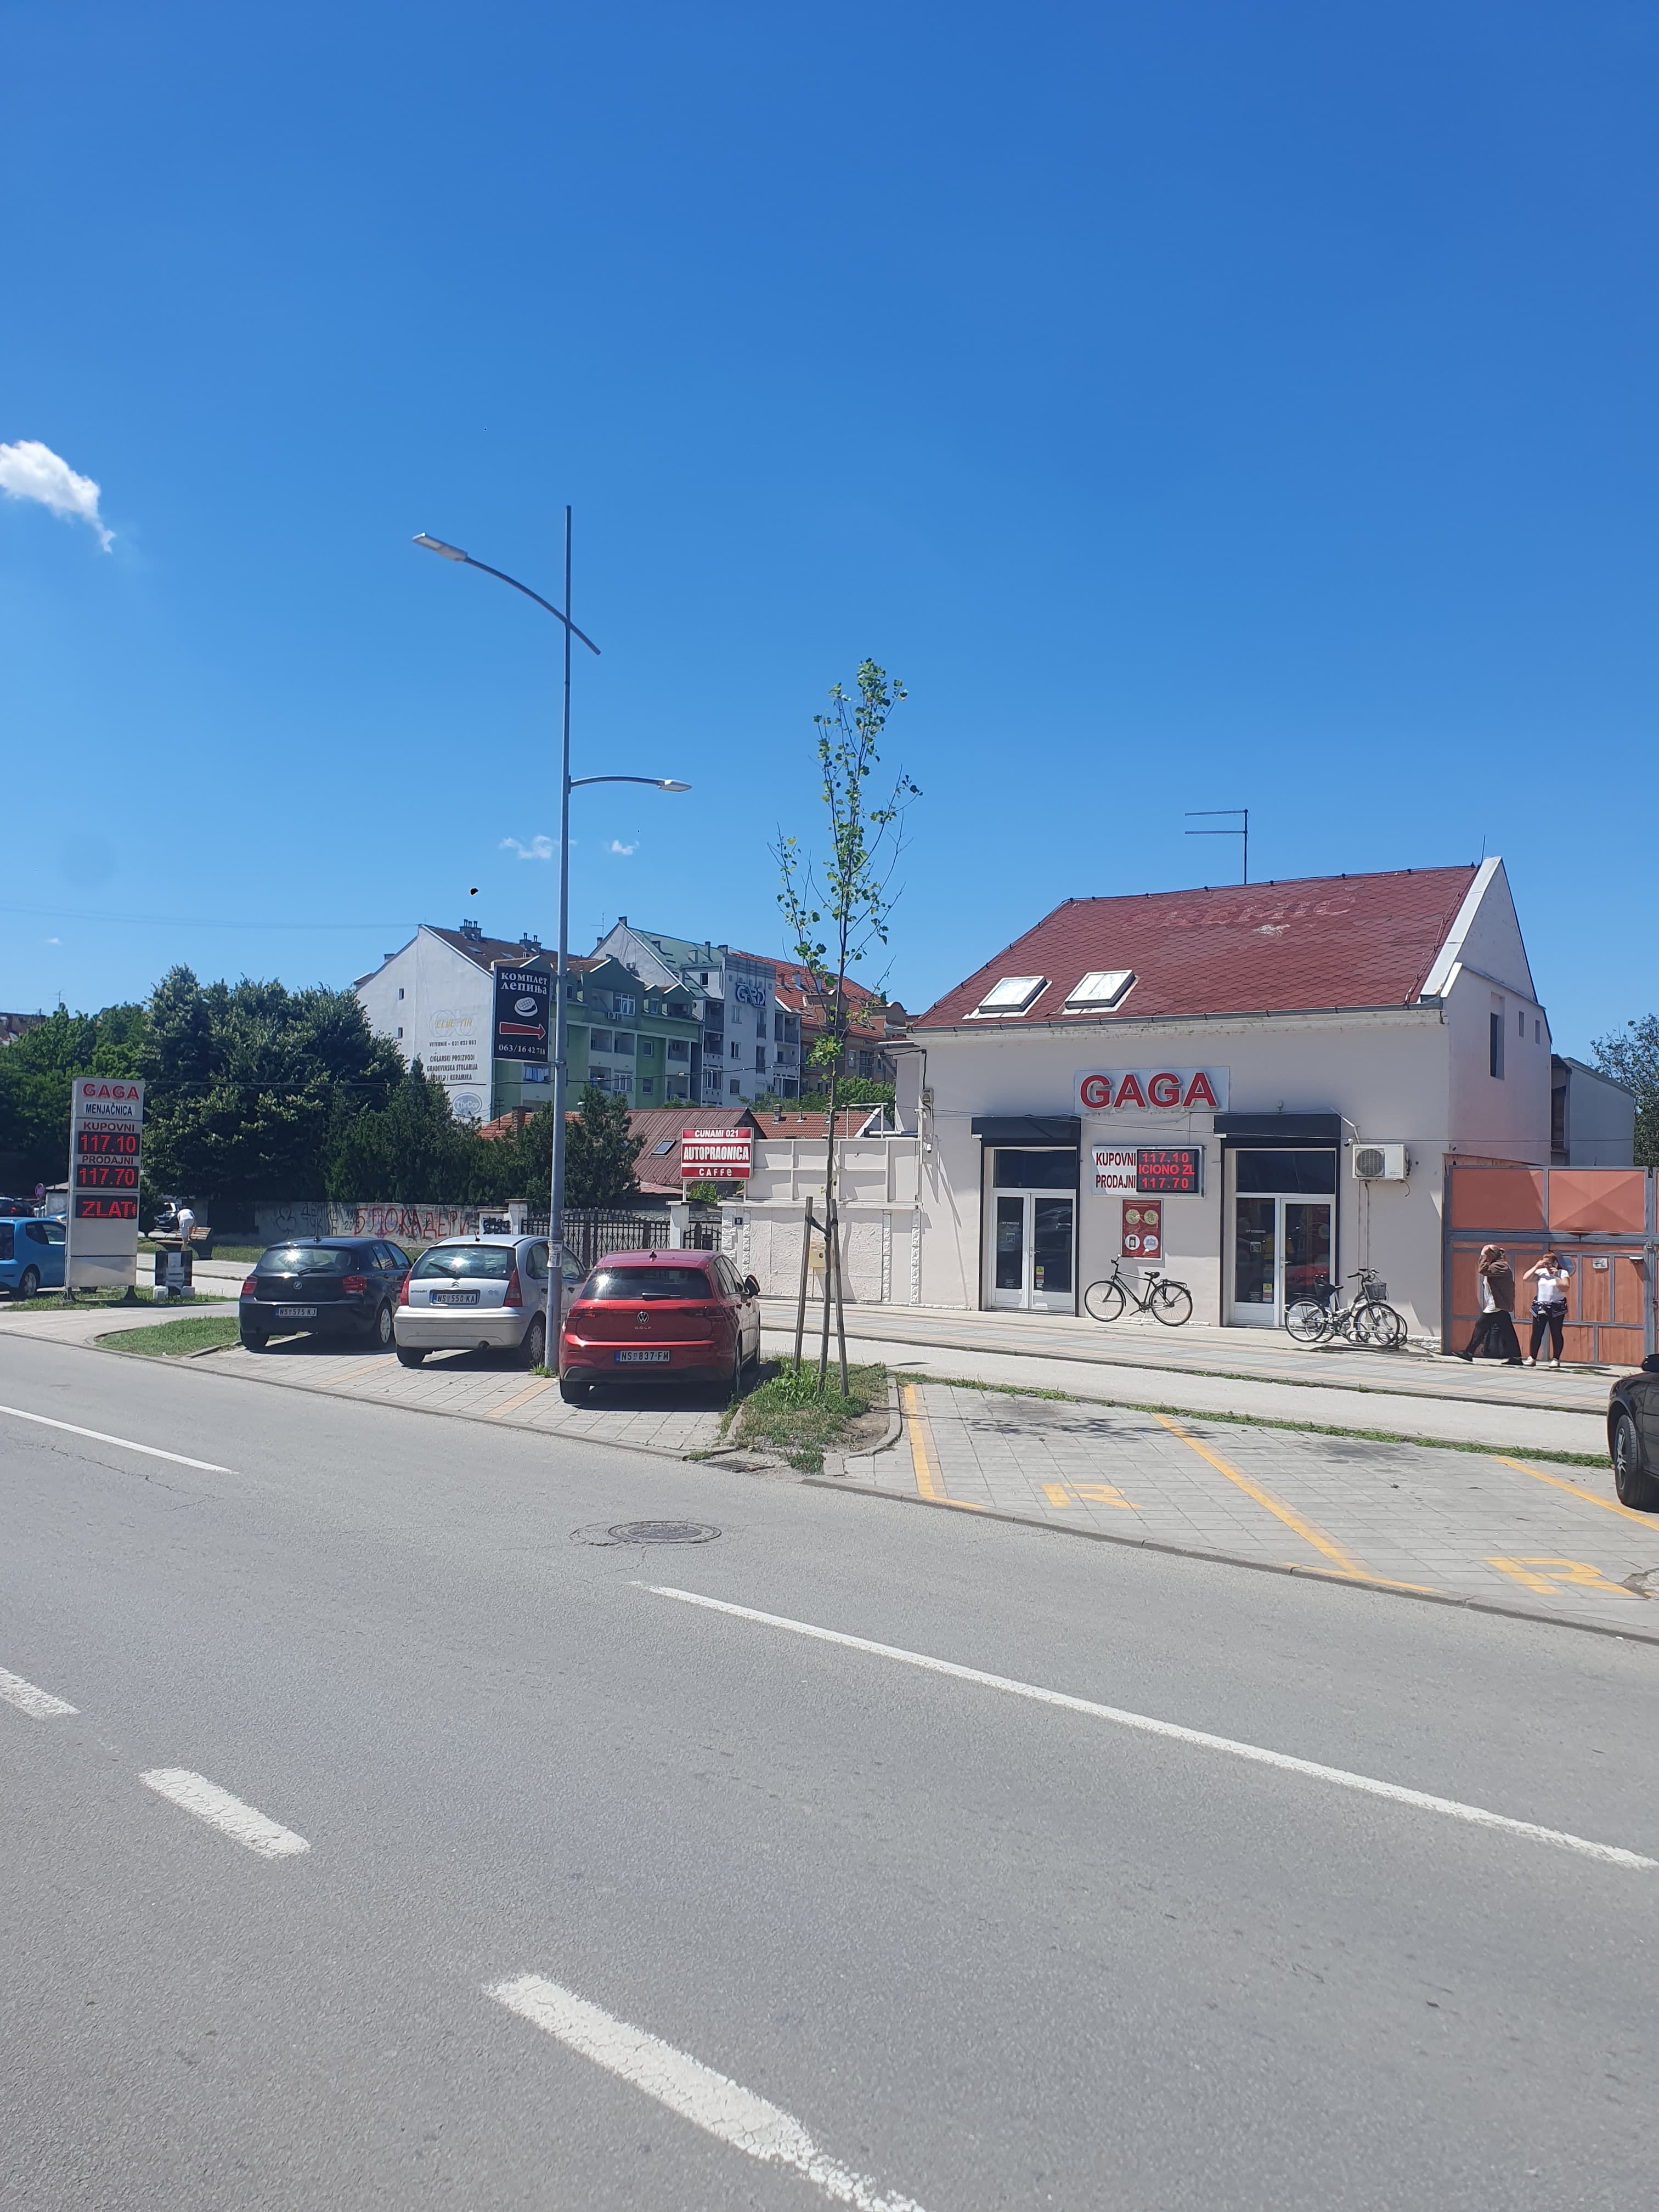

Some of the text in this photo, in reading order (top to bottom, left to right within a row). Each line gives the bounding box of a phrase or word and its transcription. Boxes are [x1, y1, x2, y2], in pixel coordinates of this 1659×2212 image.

[83, 1084, 139, 1100] GAGA
[1080, 1071, 1218, 1109] GAGA
[86, 1103, 132, 1116] MENJAČNICA
[83, 1122, 135, 1132] KUPOVNI
[81, 1134, 136, 1153] 117.10
[684, 1146, 749, 1160] AUTOPRAONICA
[1096, 1152, 1136, 1166] KUPOVNI
[1142, 1153, 1189, 1163] 117.10
[82, 1155, 134, 1165] PRODAJNI
[79, 1167, 135, 1186] 117.70
[1096, 1175, 1136, 1188] PRODAJNI
[1142, 1178, 1189, 1188] 117.70
